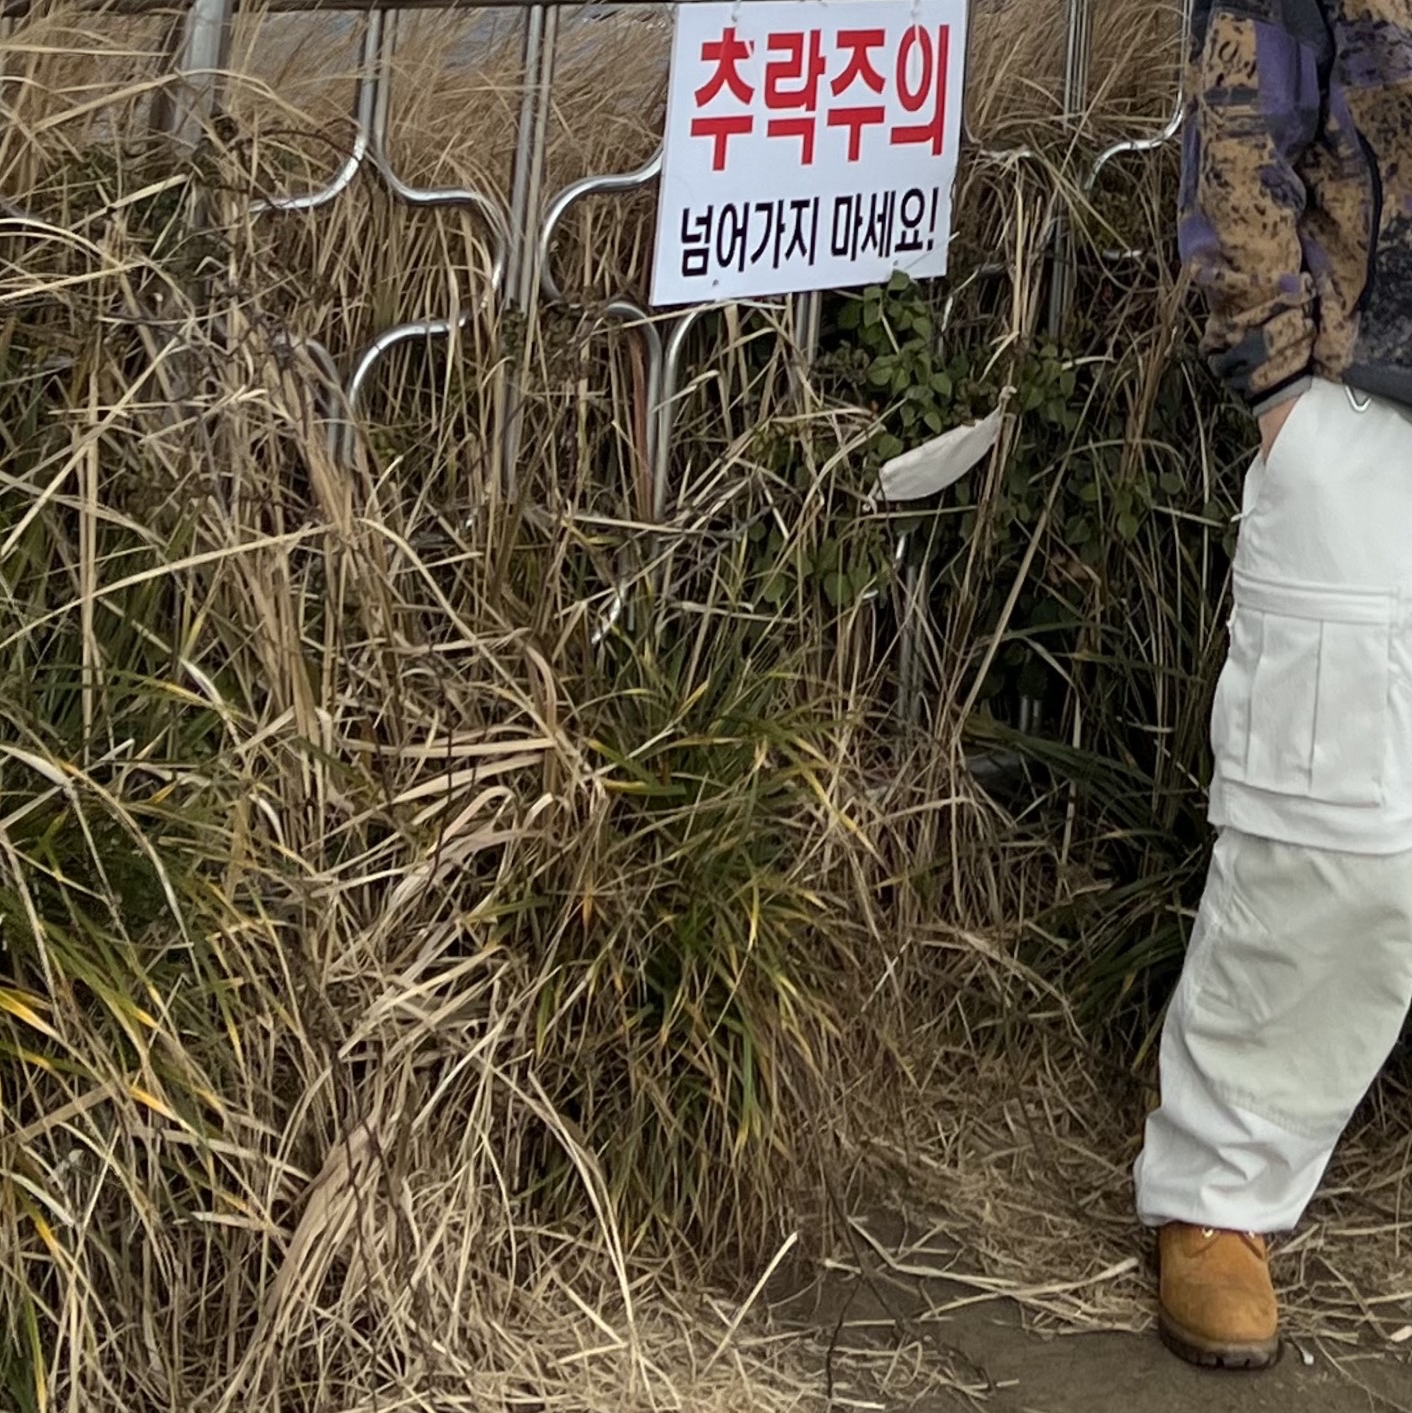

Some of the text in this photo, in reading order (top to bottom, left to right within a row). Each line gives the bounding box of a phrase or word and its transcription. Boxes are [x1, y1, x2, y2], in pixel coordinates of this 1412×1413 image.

[690, 24, 950, 171] 추락주의
[681, 187, 939, 278] 넘어가지 마세요!
